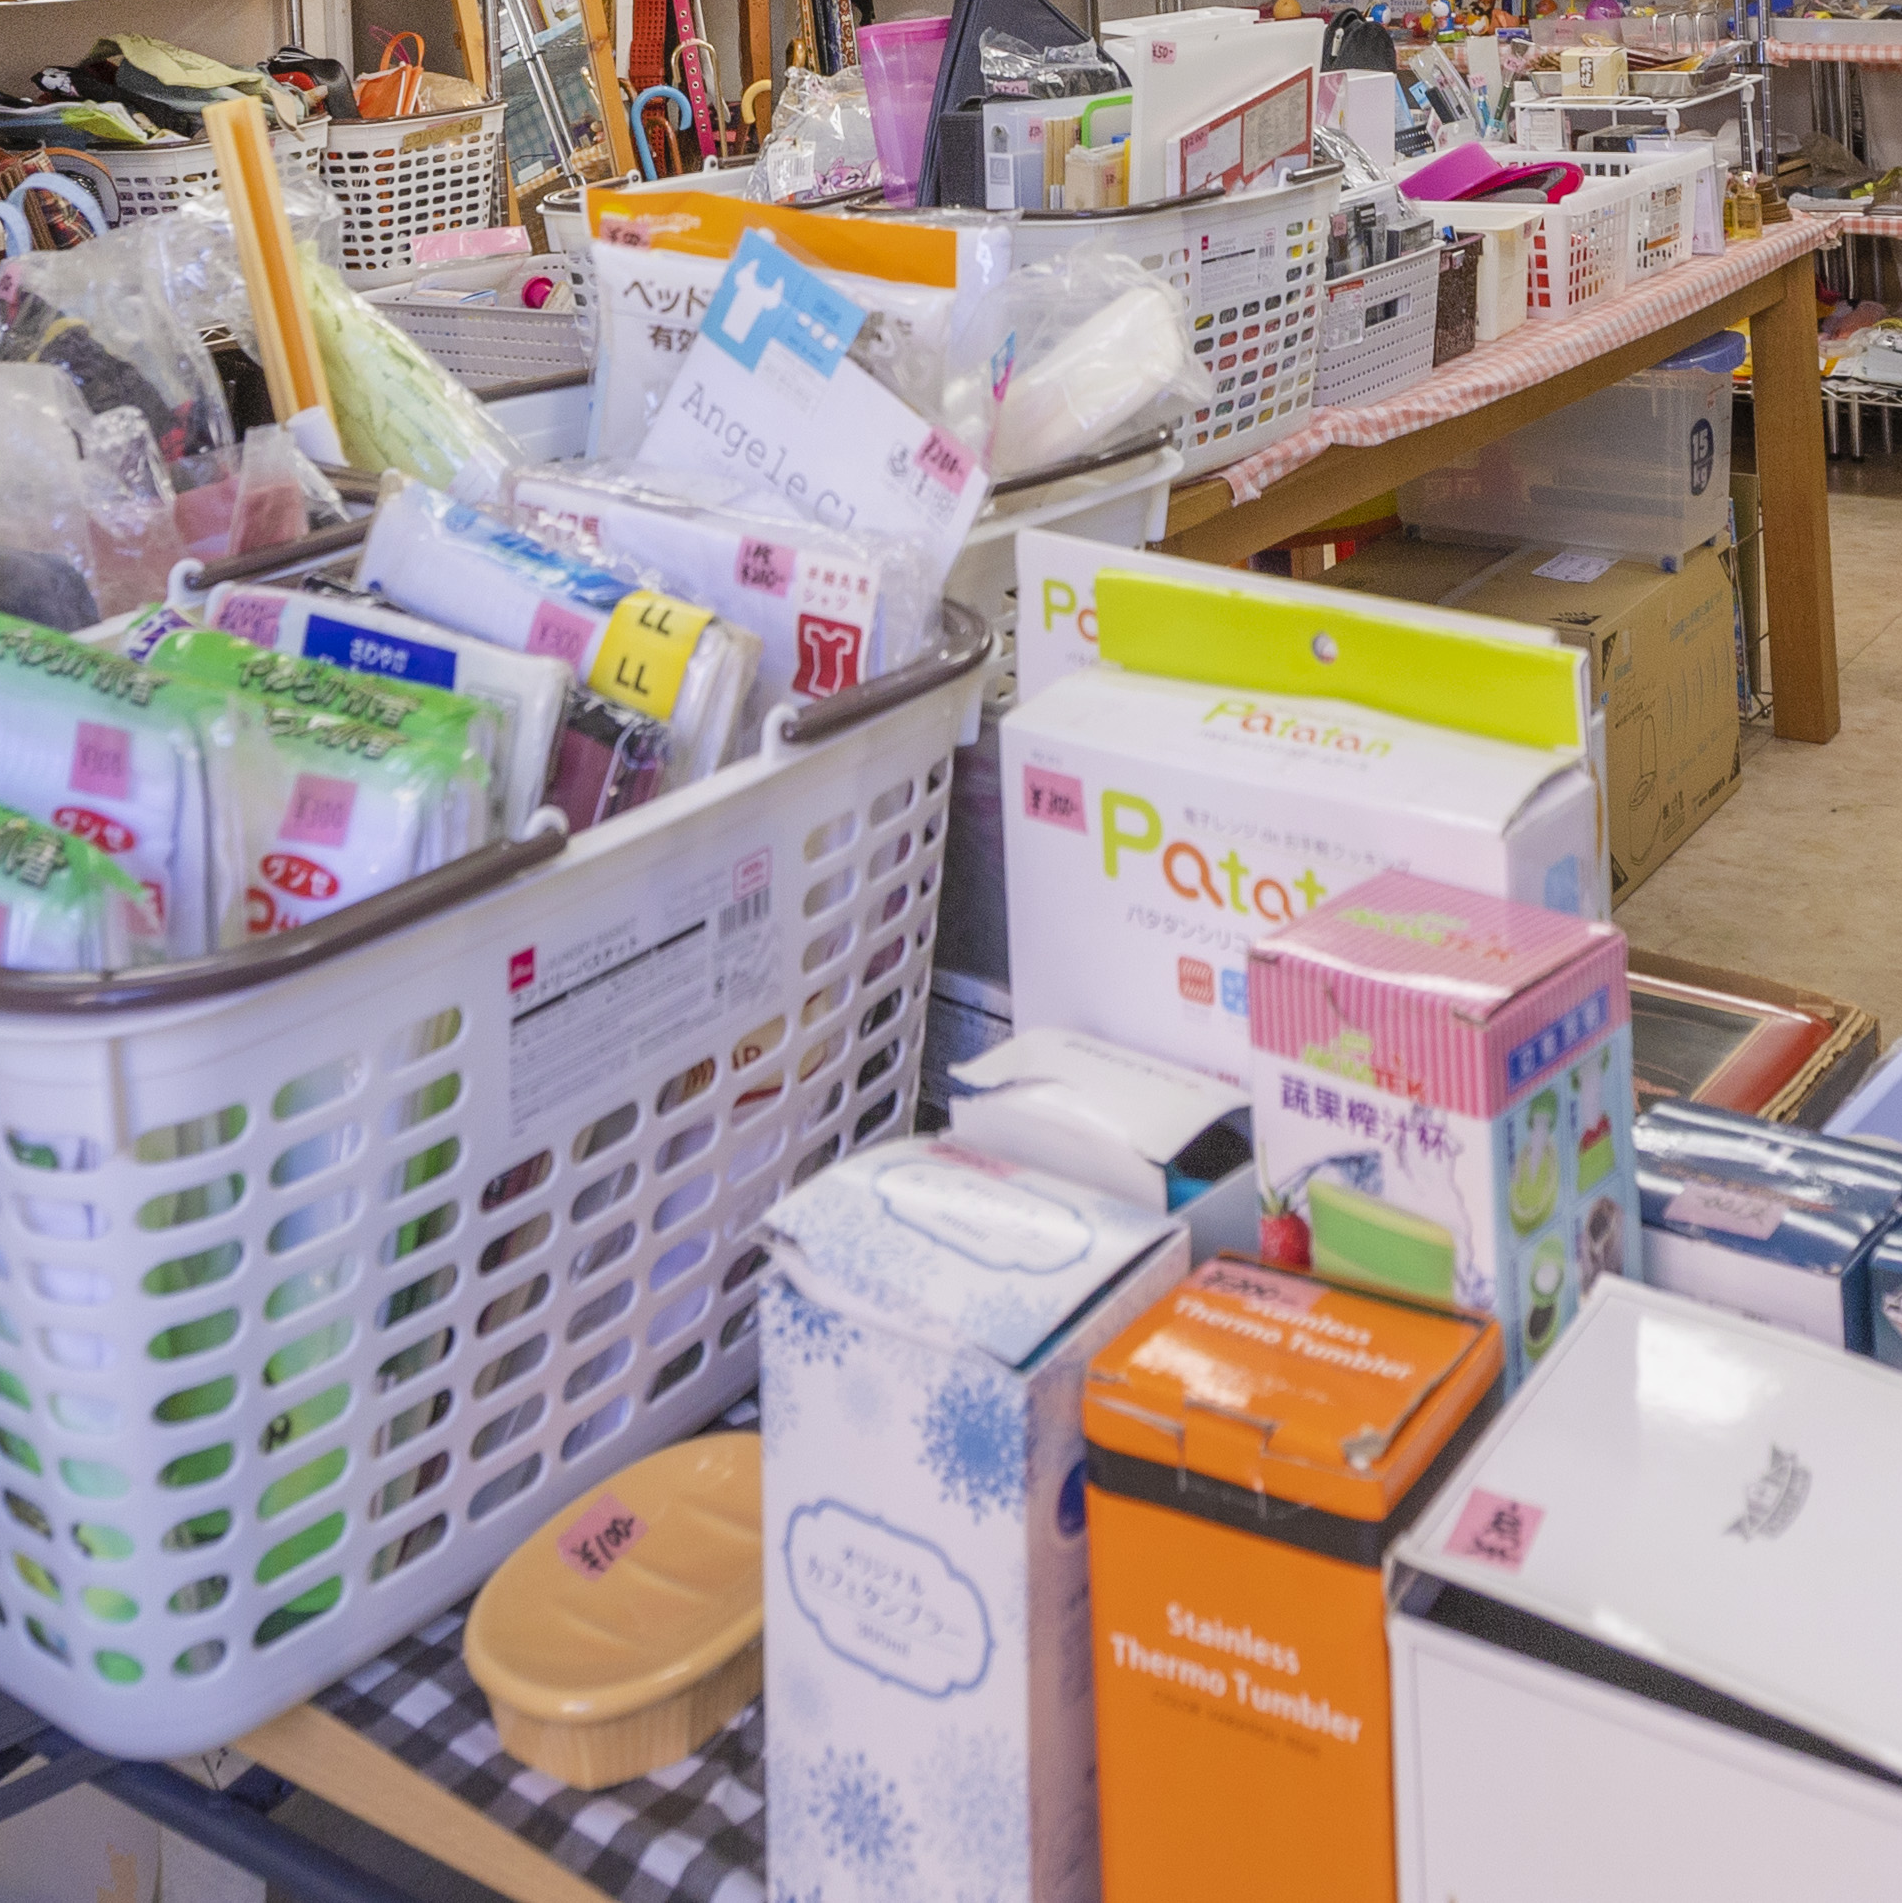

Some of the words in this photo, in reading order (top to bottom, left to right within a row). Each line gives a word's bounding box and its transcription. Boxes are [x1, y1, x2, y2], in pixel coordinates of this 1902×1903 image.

[1151, 43, 1174, 60] ¥50-
[680, 382, 808, 497] Angele
[640, 603, 673, 636] LL
[614, 655, 650, 695] LL
[1200, 700, 1393, 760] Patatan
[264, 858, 338, 896] グンゼ
[1100, 788, 1327, 926] Patat
[1175, 1295, 1282, 1351] Thermo
[1286, 1329, 1415, 1383] Tumbler
[570, 1515, 636, 1572] ¥100-
[1165, 1601, 1301, 1677] Stainless
[1110, 1631, 1228, 1699] Thermo
[1235, 1666, 1363, 1747] Tumbler
